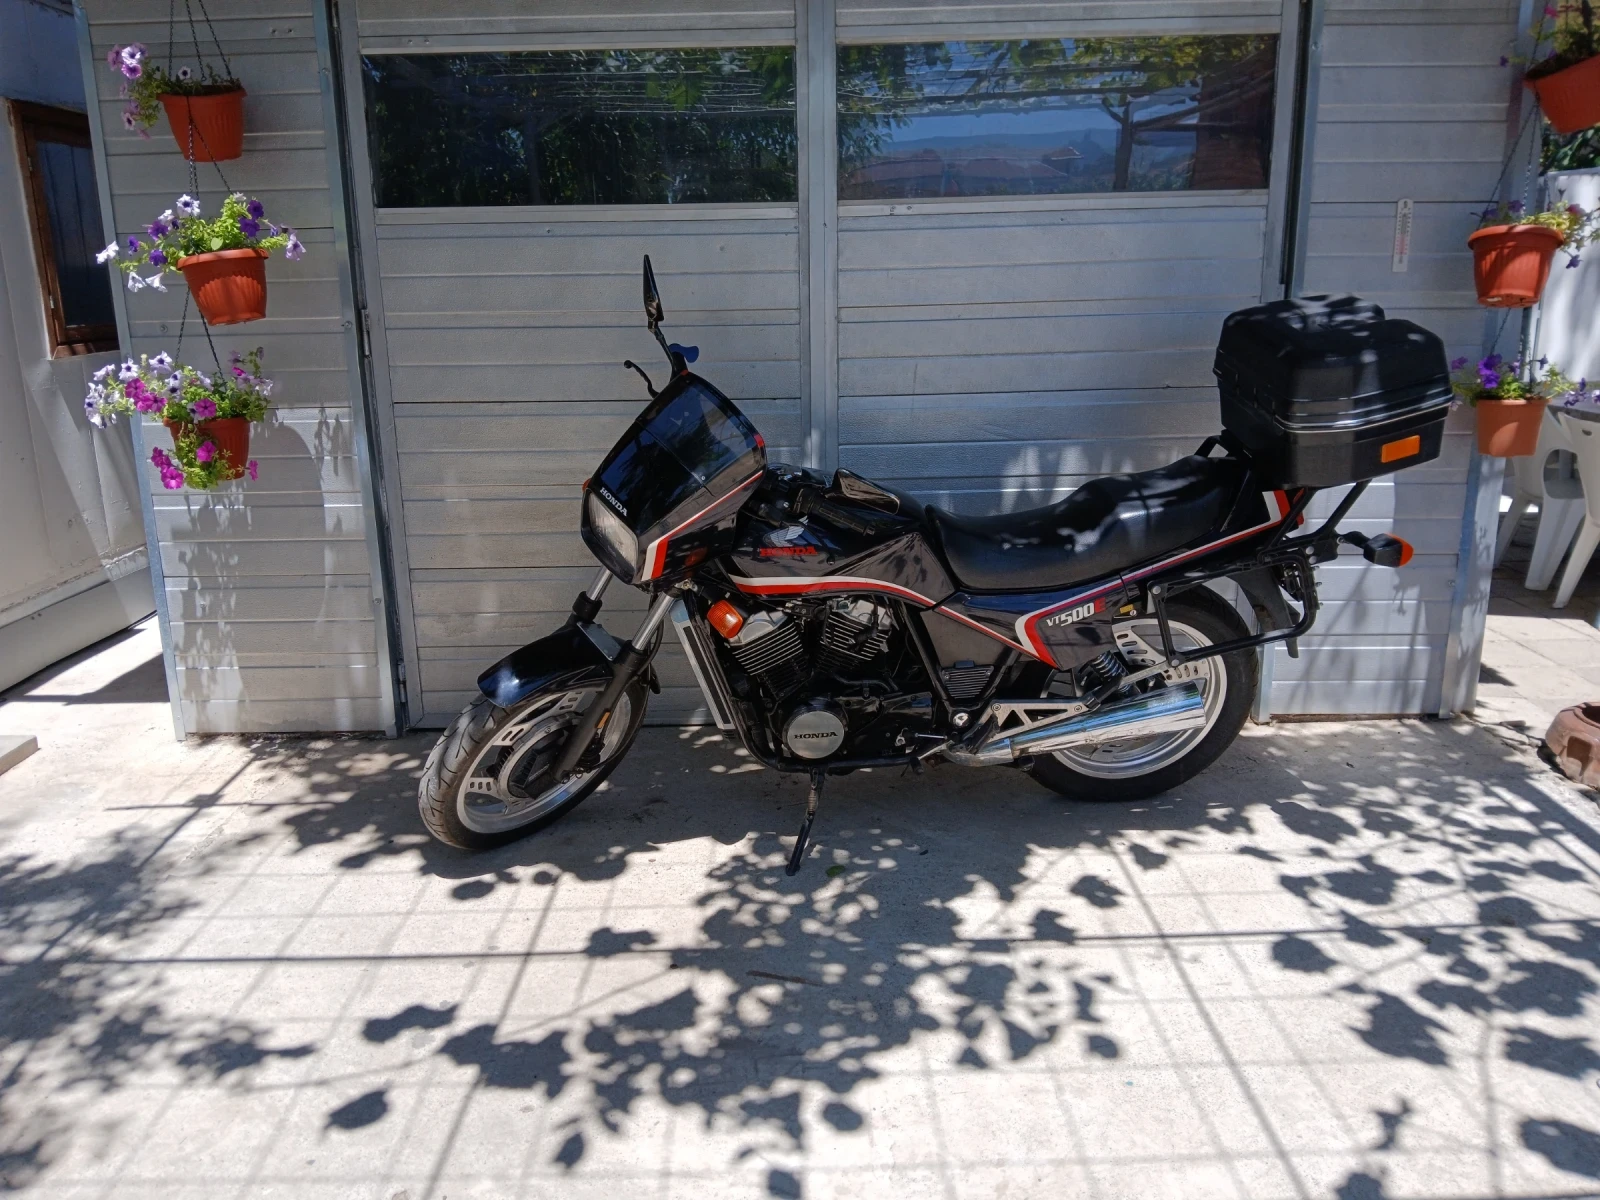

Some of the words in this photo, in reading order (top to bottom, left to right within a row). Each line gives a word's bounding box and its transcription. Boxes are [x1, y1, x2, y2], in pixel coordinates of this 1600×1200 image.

[600, 486, 627, 516] HONDA
[760, 546, 818, 557] HONDA
[794, 731, 838, 739] HONDA
